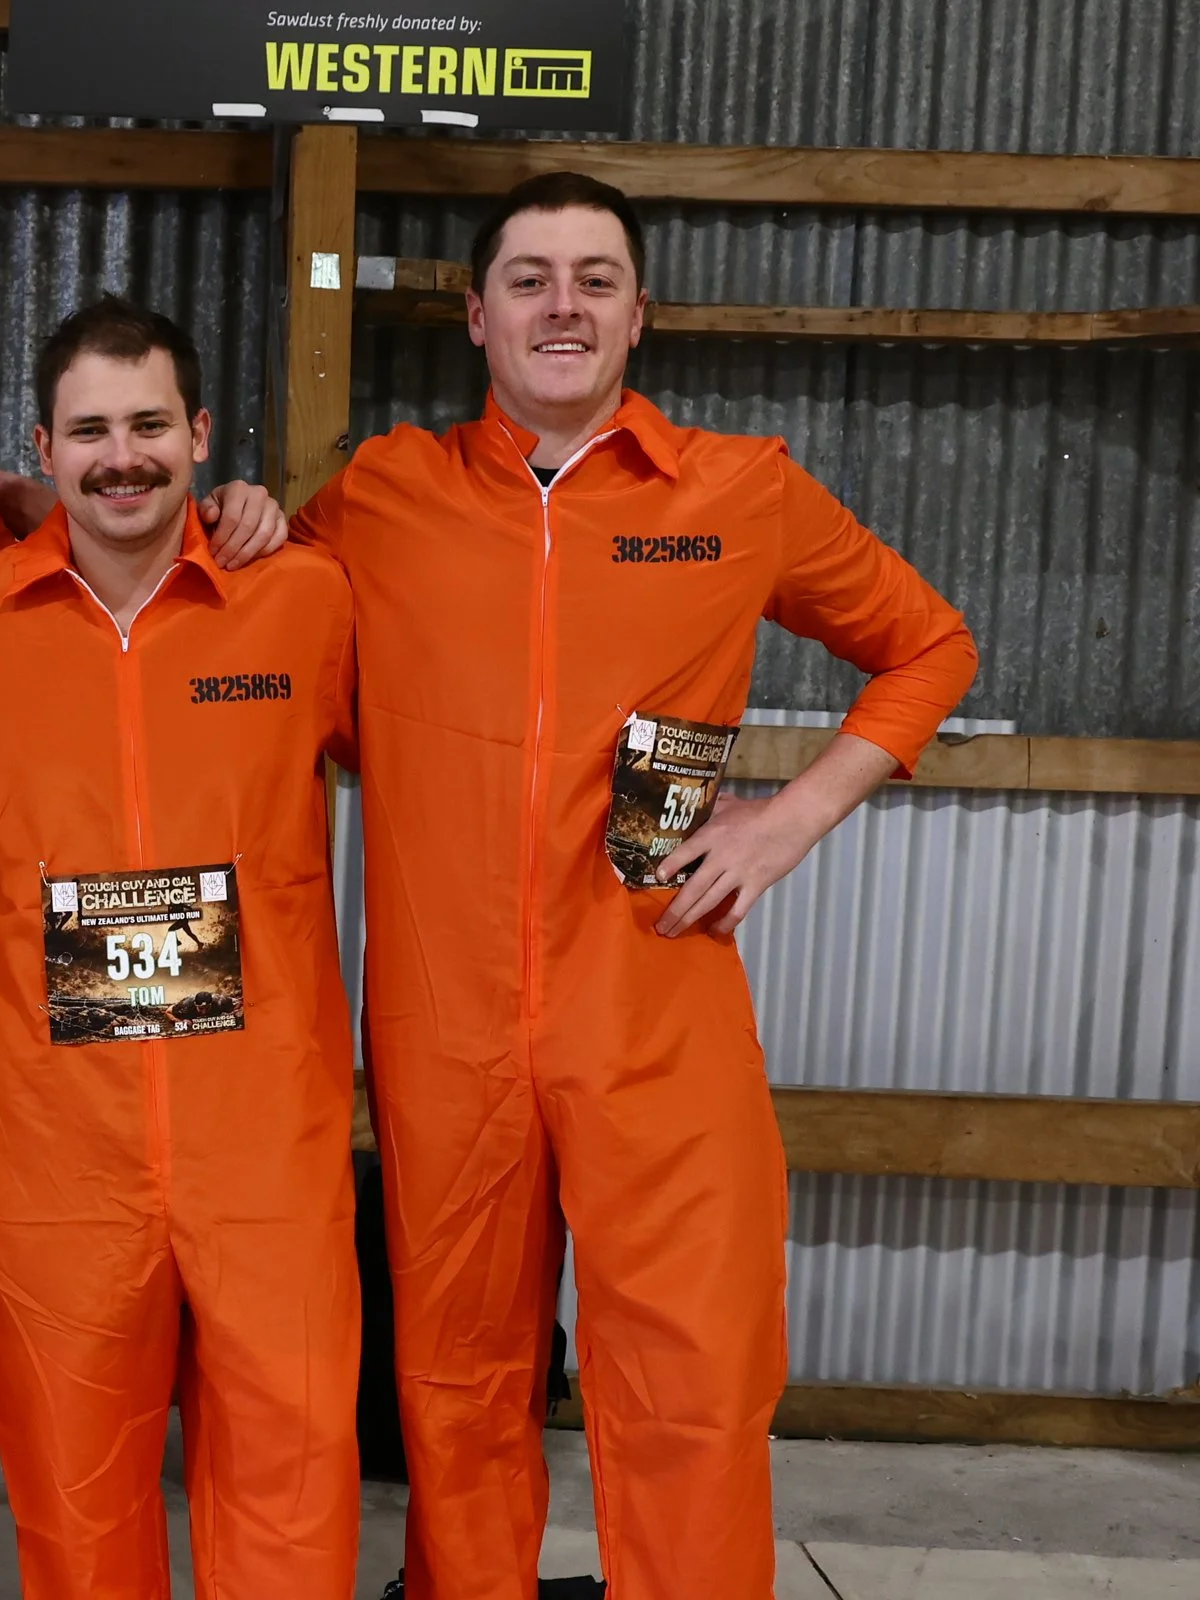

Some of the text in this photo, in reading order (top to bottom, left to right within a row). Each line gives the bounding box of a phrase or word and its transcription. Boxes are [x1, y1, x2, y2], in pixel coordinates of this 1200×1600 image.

[266, 11, 482, 35] Sawdust freshly donated by:
[265, 41, 497, 96] WESTERN
[611, 535, 722, 563] 3825869
[189, 673, 292, 704] 3825869
[661, 725, 694, 741] TOUGH
[657, 738, 723, 763] CHALLENGE
[652, 762, 667, 771] NEW
[659, 784, 701, 831] 533
[81, 876, 195, 893] TOUGH GUY AND GAL
[81, 887, 196, 910] CHALLENGE
[81, 911, 200, 926] NEW ZEALAND'S ULTIMATE MUD RUN
[107, 930, 183, 981] 534
[128, 986, 165, 1007] TOM
[114, 1021, 188, 1036] BAGGAGE TAG 534
[192, 1019, 236, 1030] CHALLENGE
